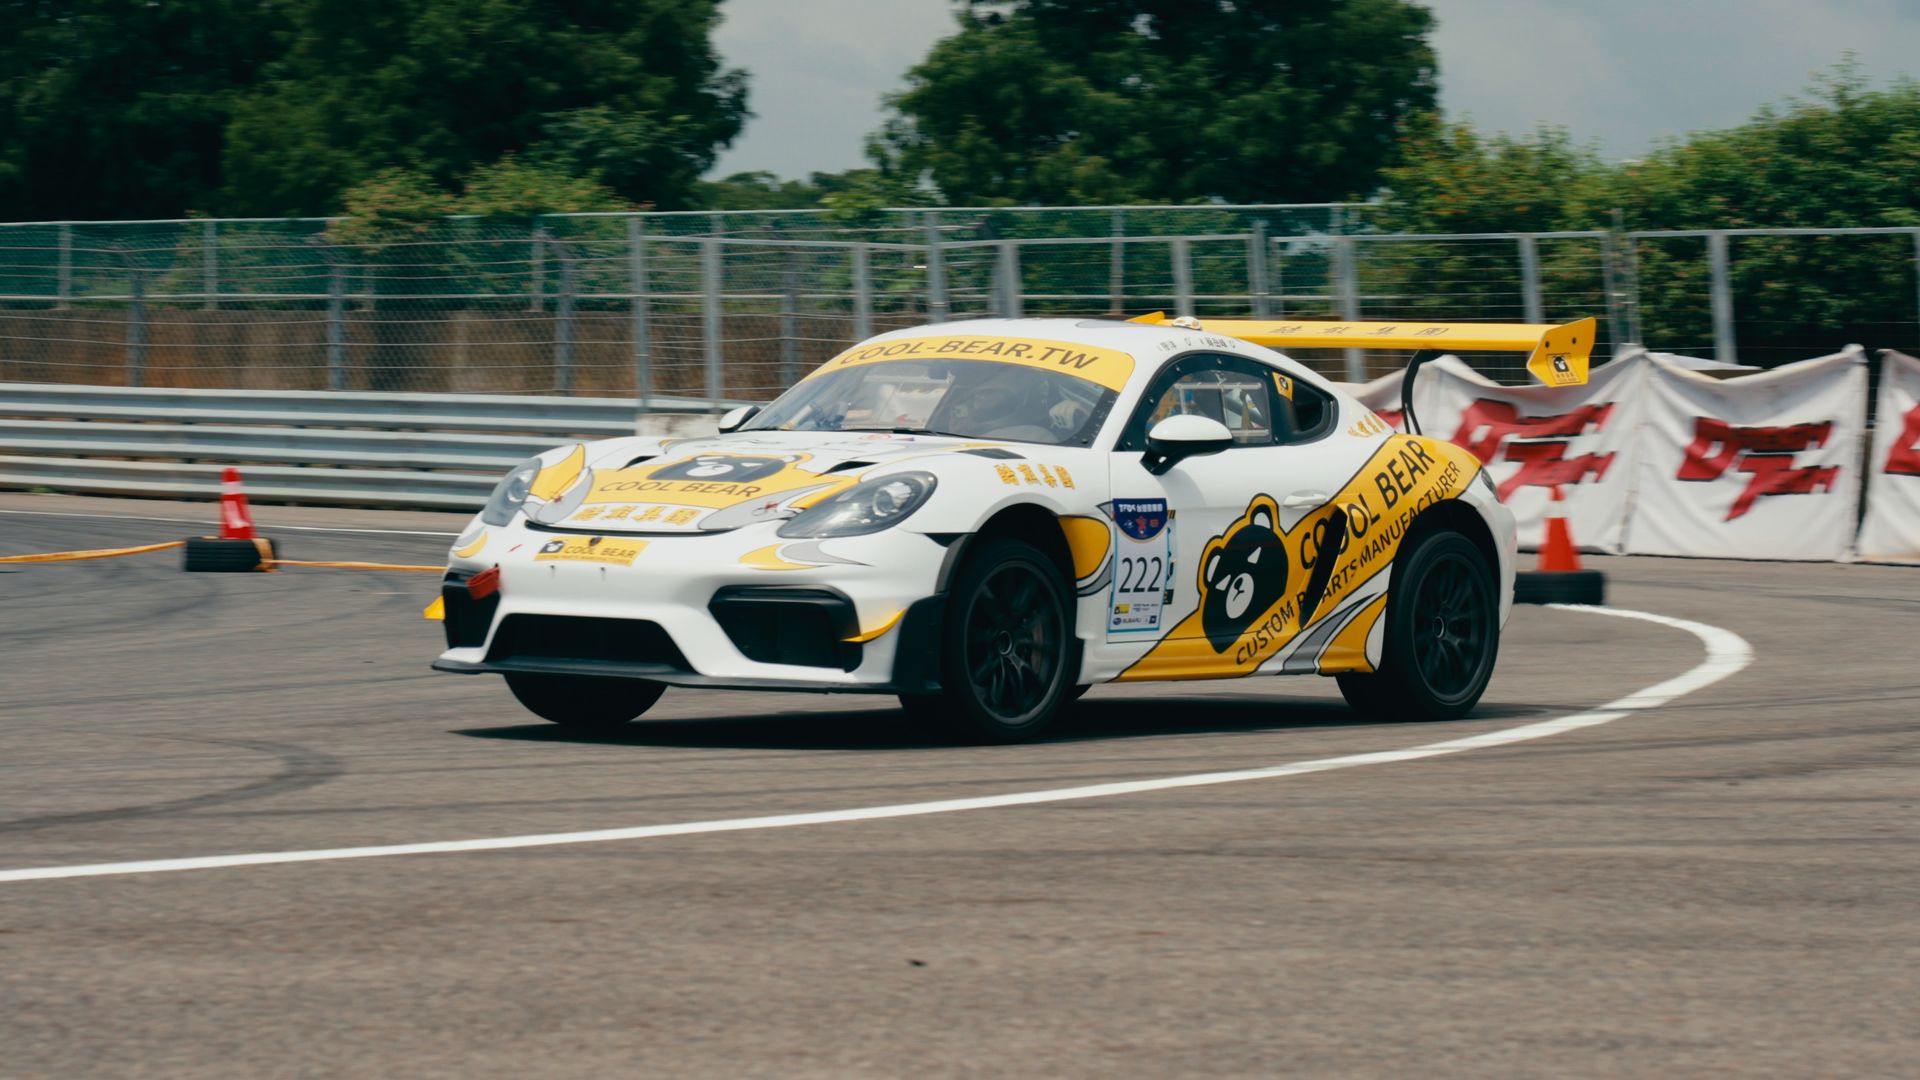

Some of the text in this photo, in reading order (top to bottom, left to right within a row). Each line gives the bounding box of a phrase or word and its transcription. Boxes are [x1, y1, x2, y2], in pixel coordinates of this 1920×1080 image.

[839, 339, 1099, 370] COOL-BEAR.TW
[599, 480, 762, 498] COOL BEAR
[1300, 493, 1381, 570] COOL
[1374, 439, 1435, 510] BEAR
[564, 545, 597, 554] COOL
[600, 547, 637, 558] BEAR
[1236, 600, 1295, 666] CUSTOM
[1360, 460, 1461, 569] MANUFACTURER
[1118, 556, 1162, 593] 222
